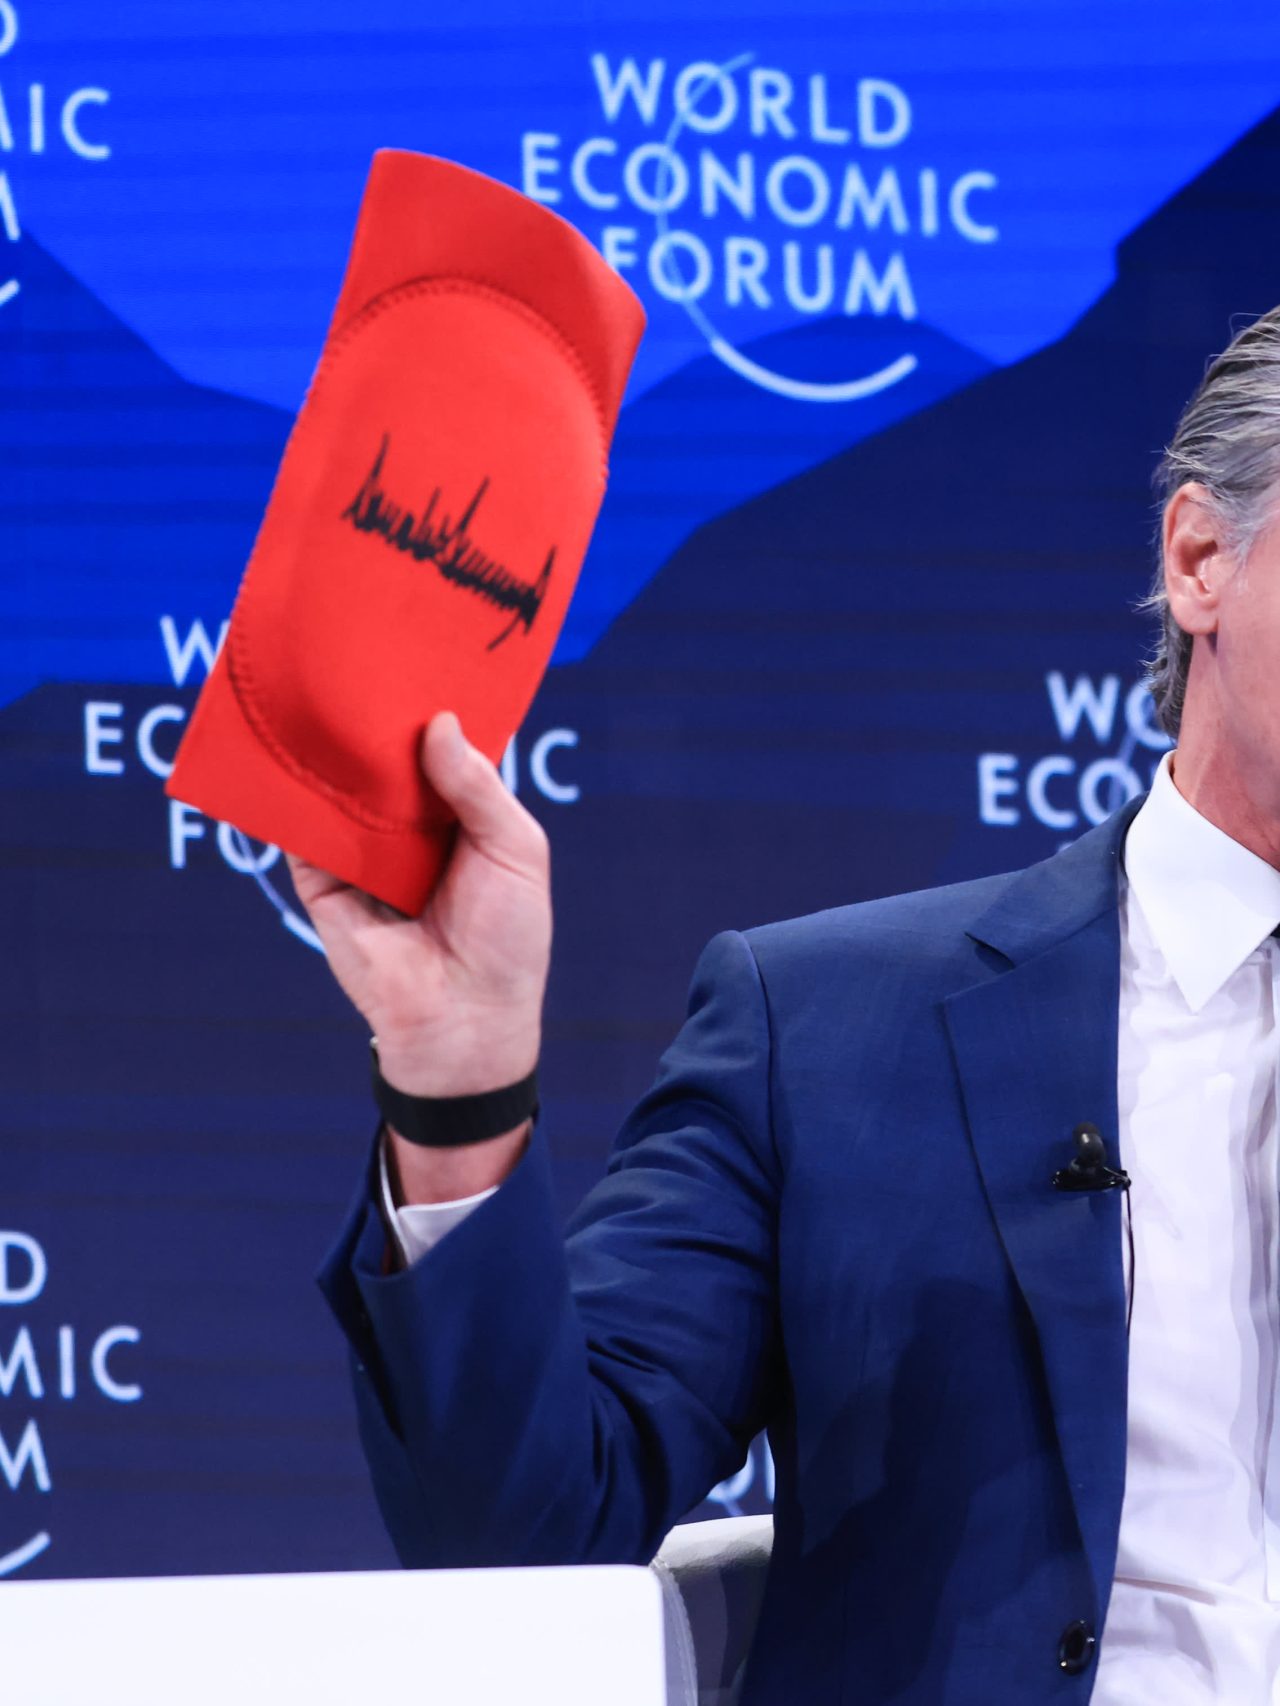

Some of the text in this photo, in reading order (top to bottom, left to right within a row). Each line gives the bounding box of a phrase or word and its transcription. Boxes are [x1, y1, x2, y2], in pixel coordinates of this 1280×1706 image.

[591, 53, 911, 148] WORLD
[522, 132, 998, 243] ECONOMIC
[602, 226, 917, 320] FORUM
